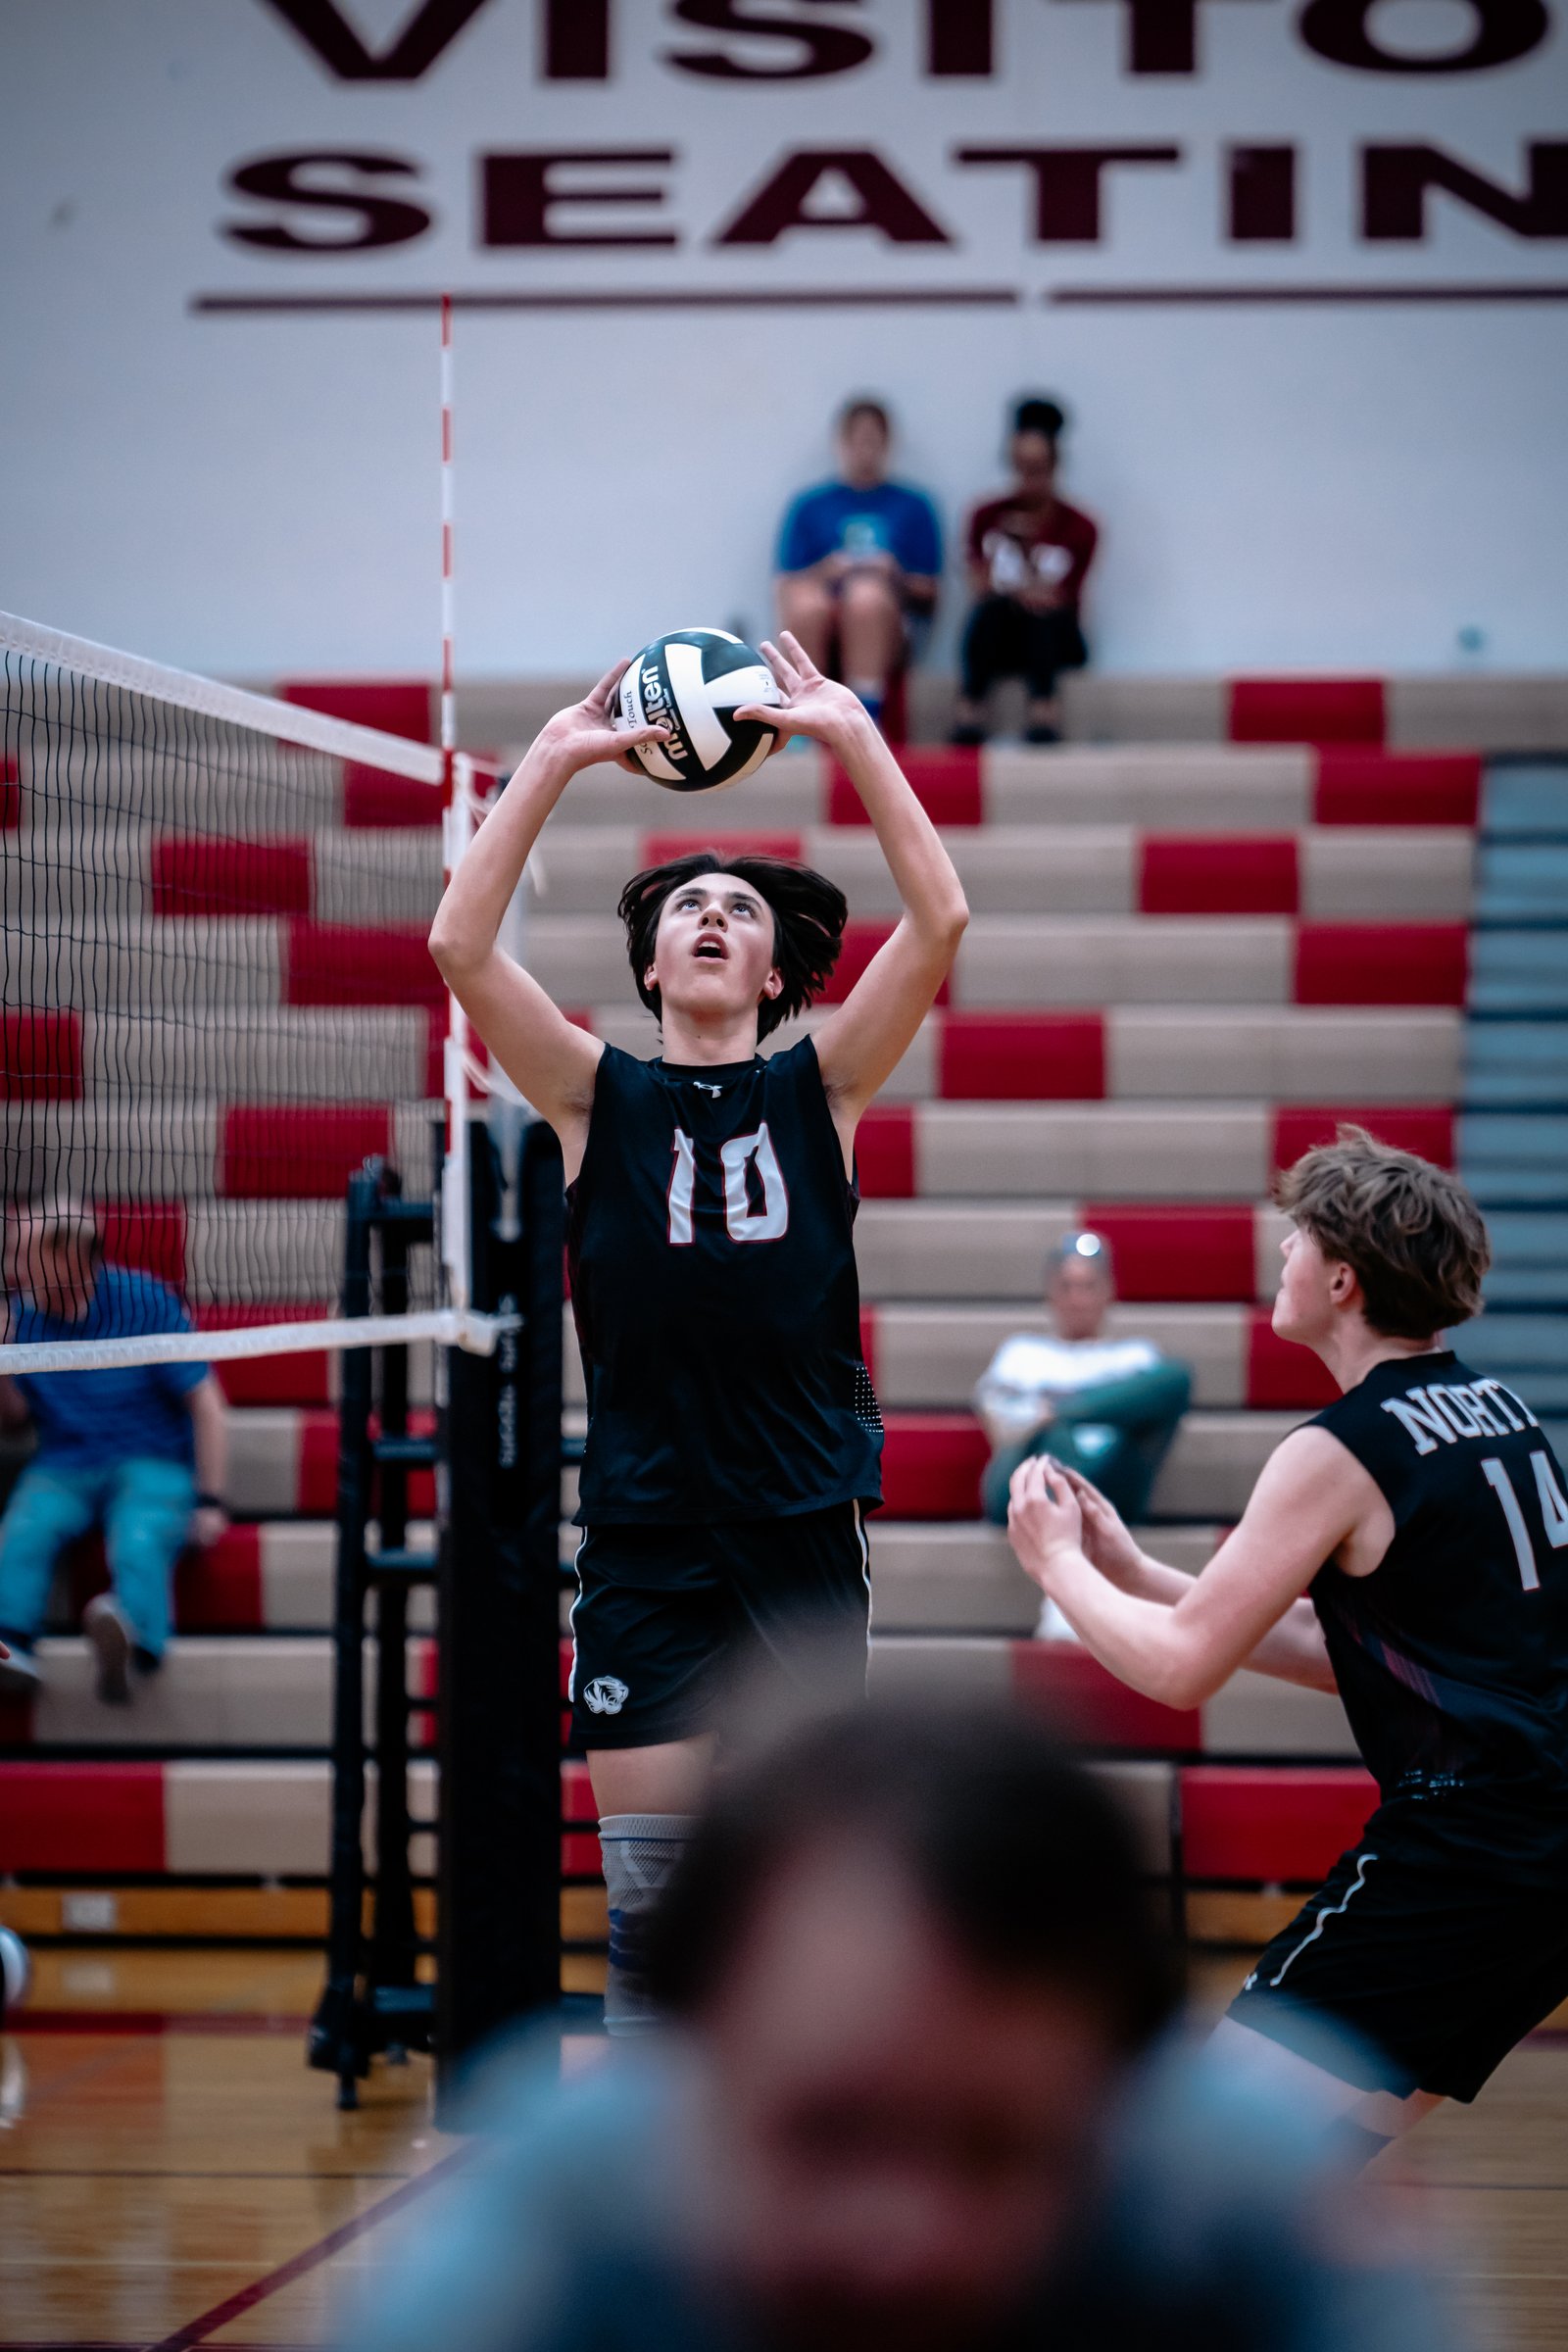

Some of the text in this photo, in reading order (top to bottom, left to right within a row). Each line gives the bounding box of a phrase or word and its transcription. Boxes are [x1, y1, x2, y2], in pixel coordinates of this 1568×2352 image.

[220, 144, 1568, 249] SEATIN
[623, 691, 637, 729] Touch
[667, 1121, 788, 1245] 10
